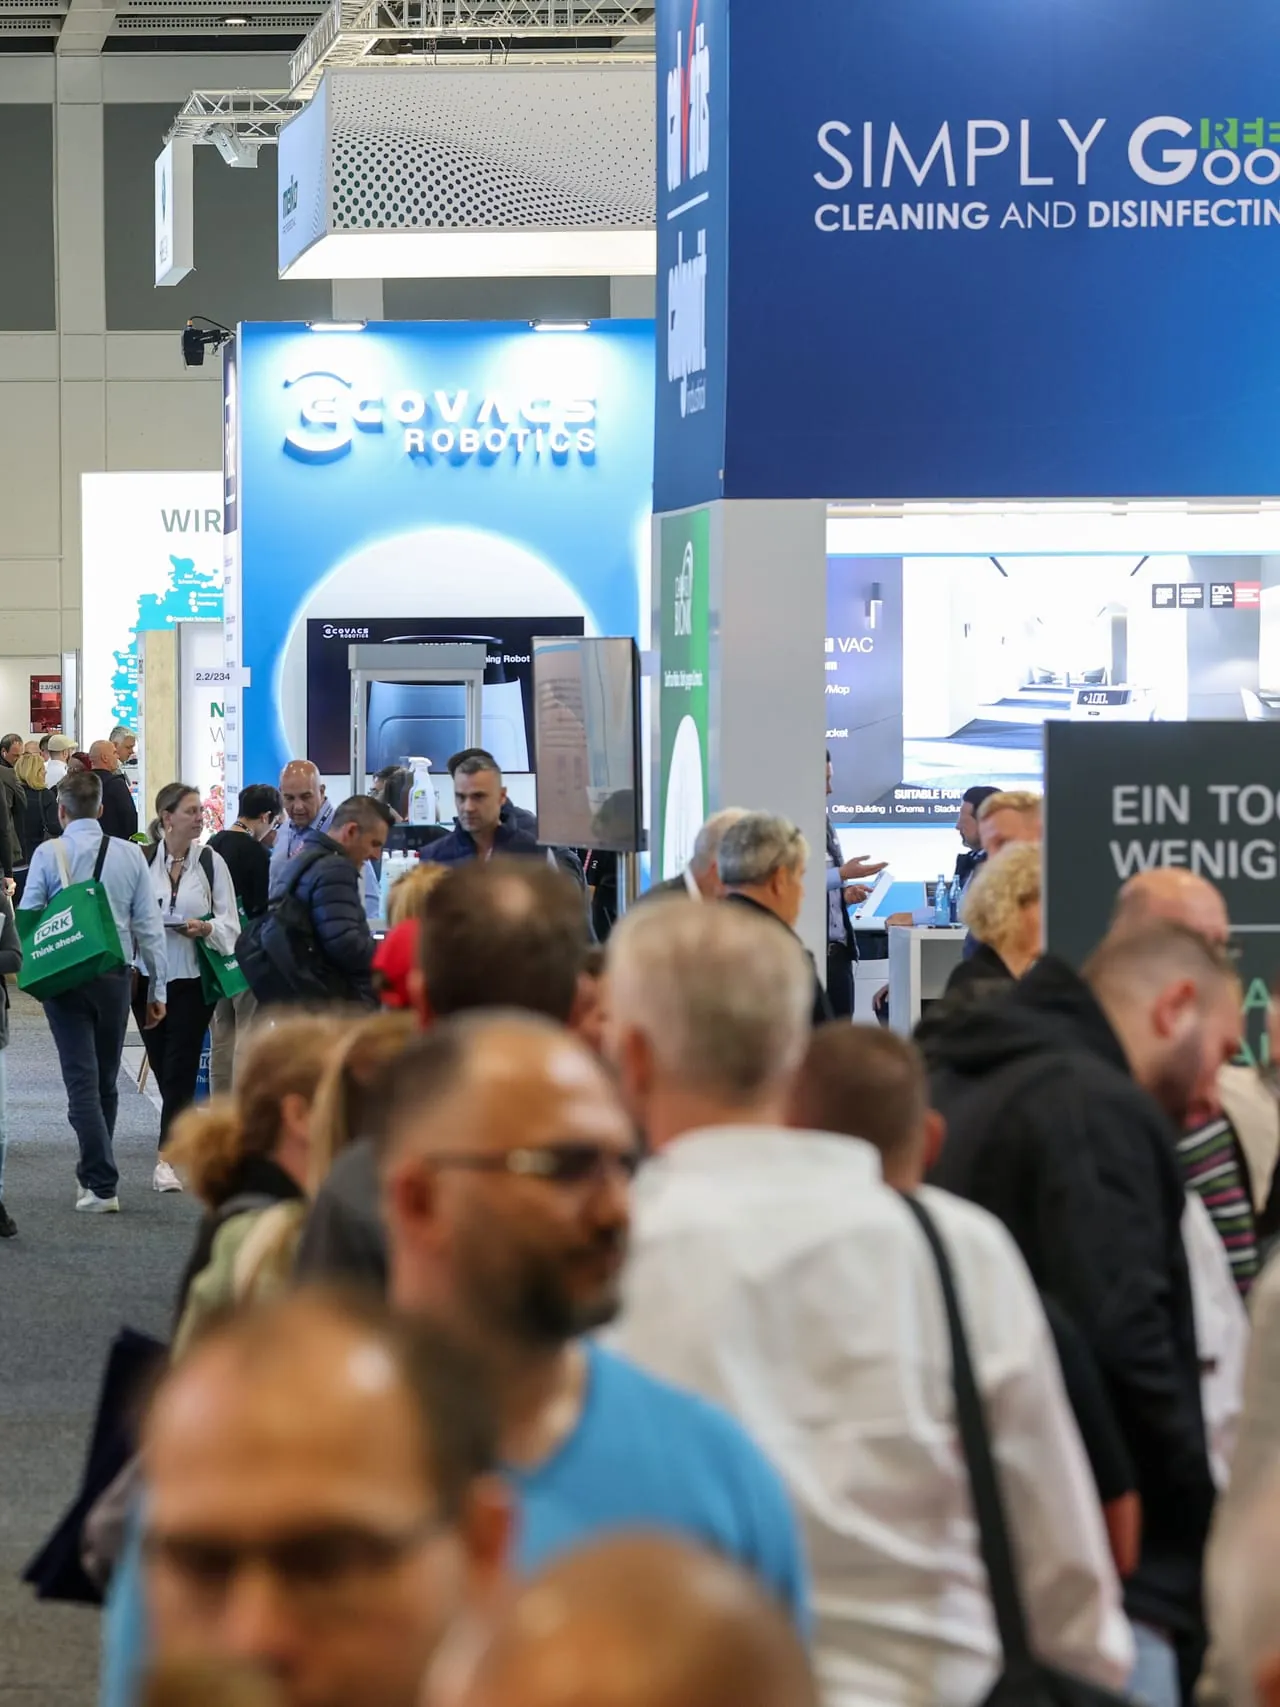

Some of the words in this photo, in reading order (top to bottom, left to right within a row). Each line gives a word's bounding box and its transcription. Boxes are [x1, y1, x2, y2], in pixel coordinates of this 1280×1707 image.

[813, 117, 1107, 190] SIMPLY
[814, 201, 990, 232] CLEANING
[1000, 201, 1077, 229] AND
[1088, 199, 1280, 228] DISINFECTIN
[300, 388, 597, 424] ECOVACS
[404, 427, 596, 453] ROBOTICS
[160, 508, 222, 533] WIR
[324, 627, 369, 635] ECOVACS
[837, 637, 874, 653] VAC
[503, 655, 530, 663] Robot
[195, 672, 231, 681] 2.2/234
[894, 789, 939, 800] SUITABLE
[941, 789, 961, 800] FOR
[1111, 784, 1190, 826] EIN
[1206, 784, 1280, 826] TO
[831, 805, 854, 814] Office
[855, 805, 886, 815] Building
[895, 805, 925, 814] Cinema
[36, 914, 70, 941] TORK
[30, 944, 55, 960] Think
[55, 930, 85, 949] ahead.
